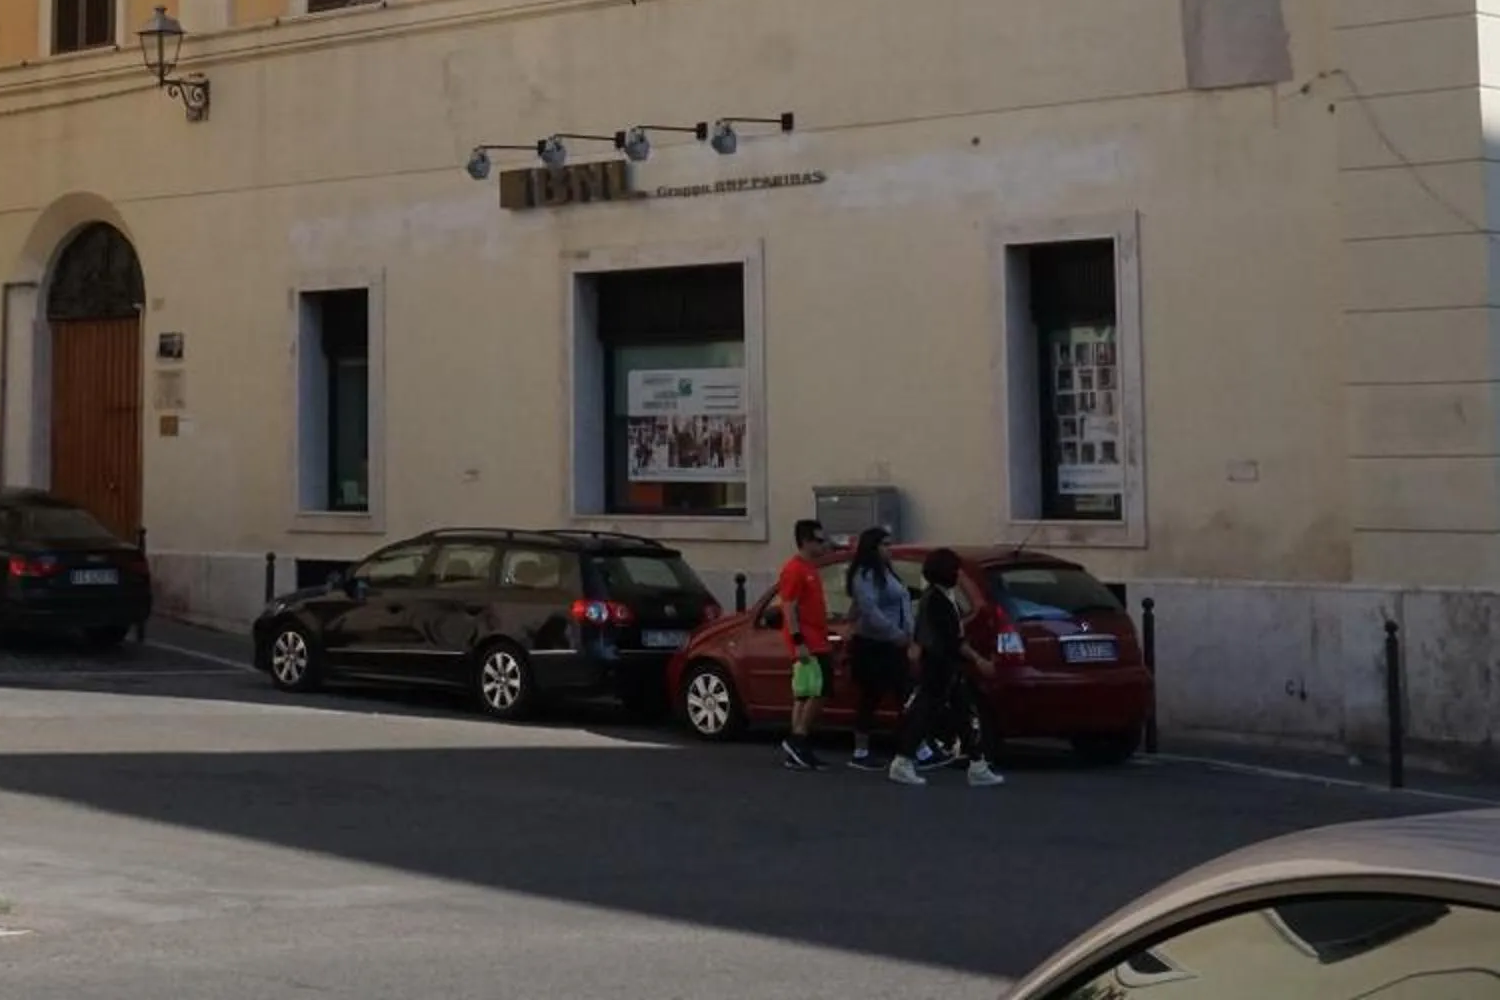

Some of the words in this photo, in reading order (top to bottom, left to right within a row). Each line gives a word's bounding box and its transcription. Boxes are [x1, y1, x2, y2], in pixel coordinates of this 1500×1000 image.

[657, 184, 710, 198] Gruppo
[714, 178, 749, 193] BNP
[752, 170, 826, 188] PARIBAS
